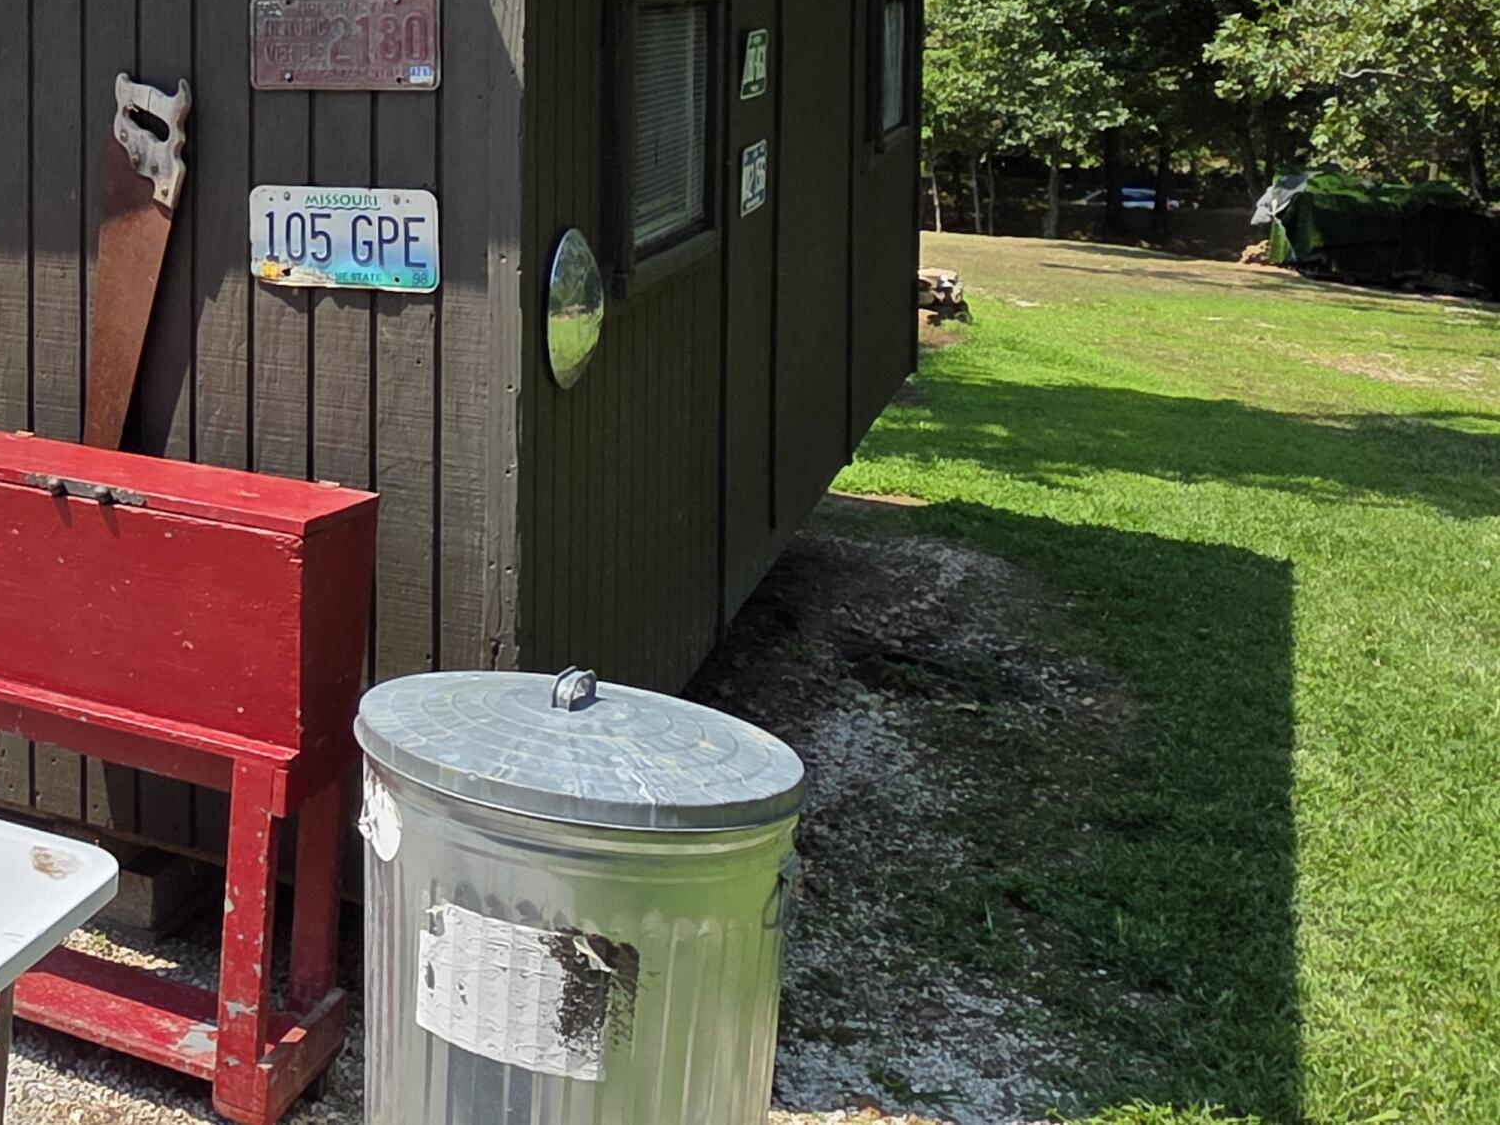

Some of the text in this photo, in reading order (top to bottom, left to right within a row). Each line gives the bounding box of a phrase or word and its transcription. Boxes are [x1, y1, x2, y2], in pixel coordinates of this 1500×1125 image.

[329, 13, 428, 65] 2180
[304, 194, 379, 206] MISSOURI
[265, 211, 426, 268] 105 GPE
